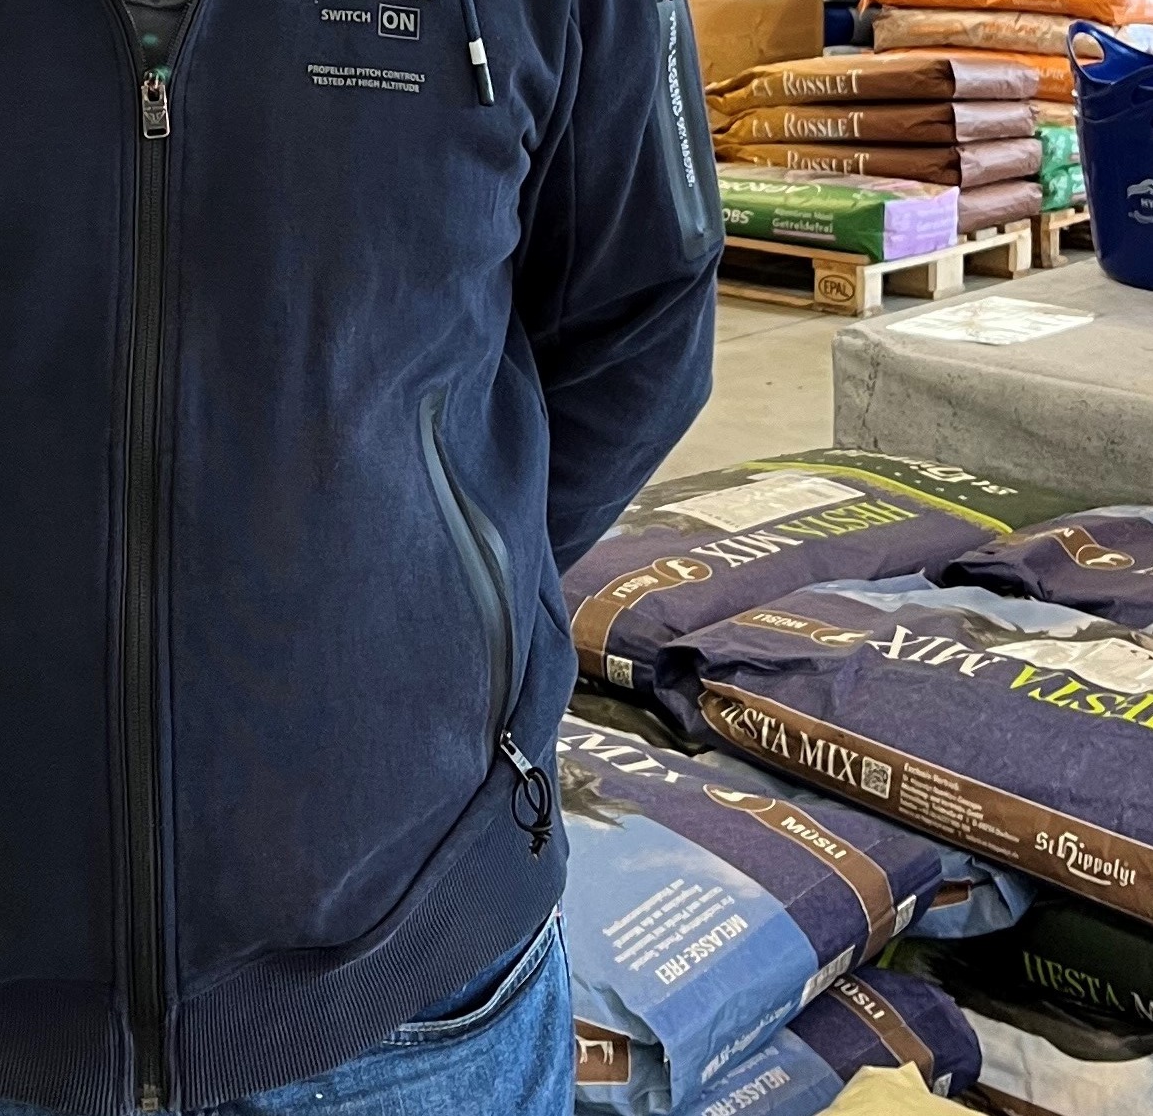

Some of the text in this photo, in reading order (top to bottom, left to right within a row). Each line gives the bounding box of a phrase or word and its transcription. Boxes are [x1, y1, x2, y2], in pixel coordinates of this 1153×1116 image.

[321, 9, 415, 32] SWITCH ON
[307, 64, 425, 83] PROPELLER PITCH CONTROLS
[312, 75, 420, 93] TESTED AT HIGH ALTITUDE
[782, 69, 863, 97] ROSSLET
[752, 111, 864, 138] LA ROSSLET
[722, 208, 754, 225] OBS
[823, 280, 848, 296] EPAL
[690, 530, 803, 568] MIX
[866, 624, 1008, 678] MIX
[798, 730, 859, 786] MIX
[781, 816, 847, 860] MÜSLI
[1057, 832, 1137, 886] Hippolyt
[655, 914, 749, 985] MELASSE-FREI
[834, 978, 885, 1020] ÜSLI
